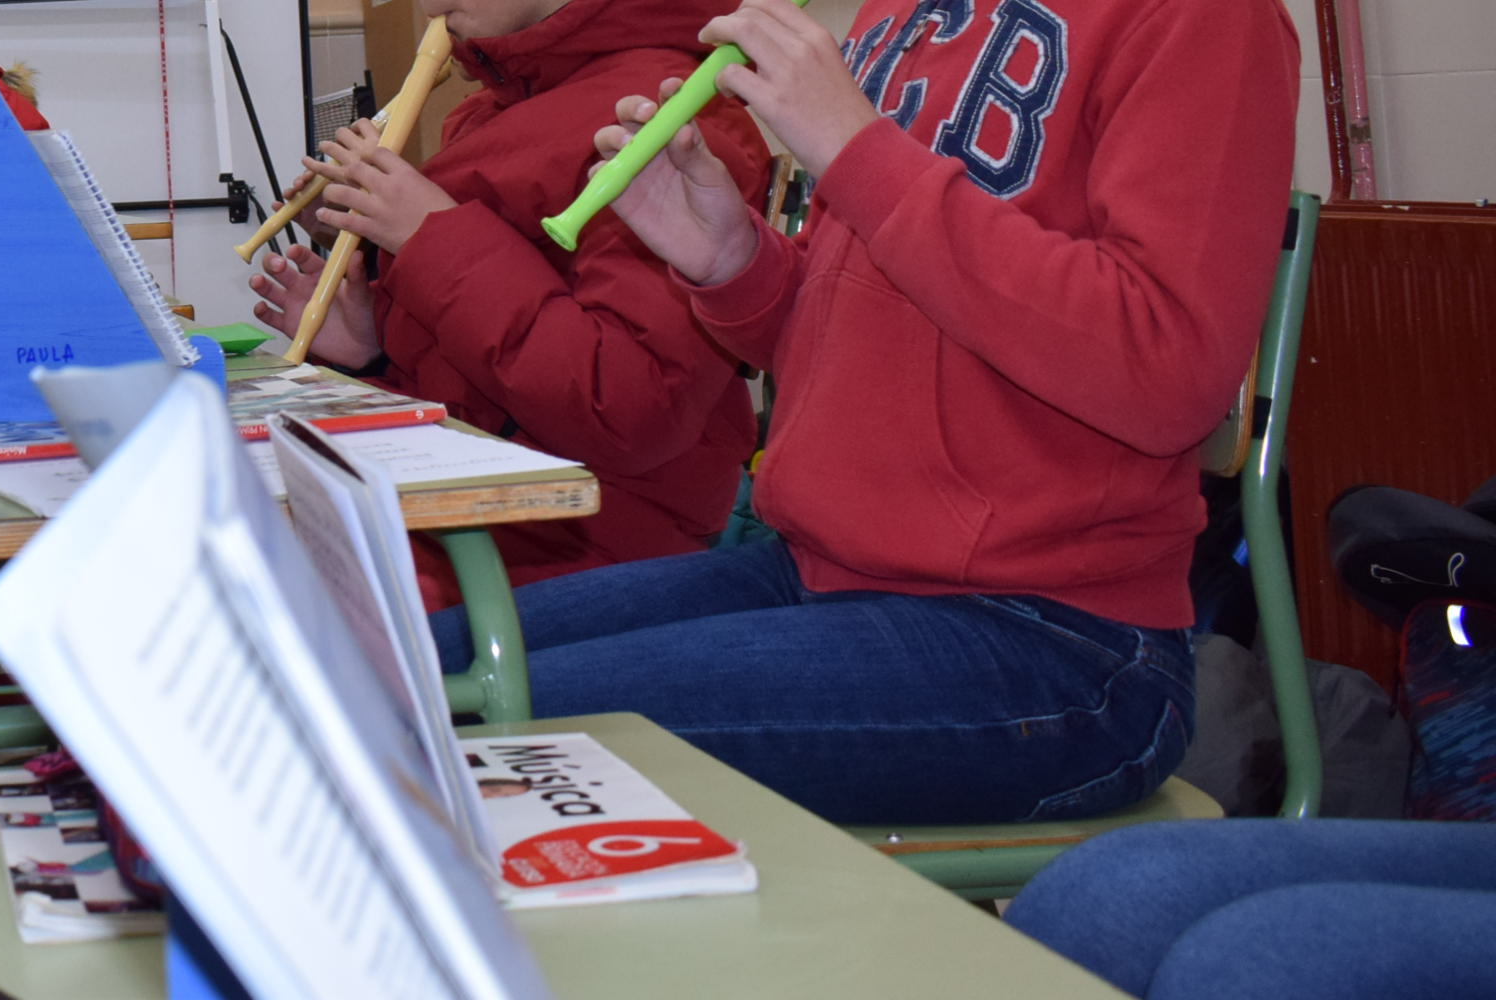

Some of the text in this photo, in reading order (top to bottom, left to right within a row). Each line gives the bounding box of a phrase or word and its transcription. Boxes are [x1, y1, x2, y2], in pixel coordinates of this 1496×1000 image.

[16, 343, 75, 364] PAULA
[488, 743, 606, 817] Música
[587, 835, 702, 858] 6
